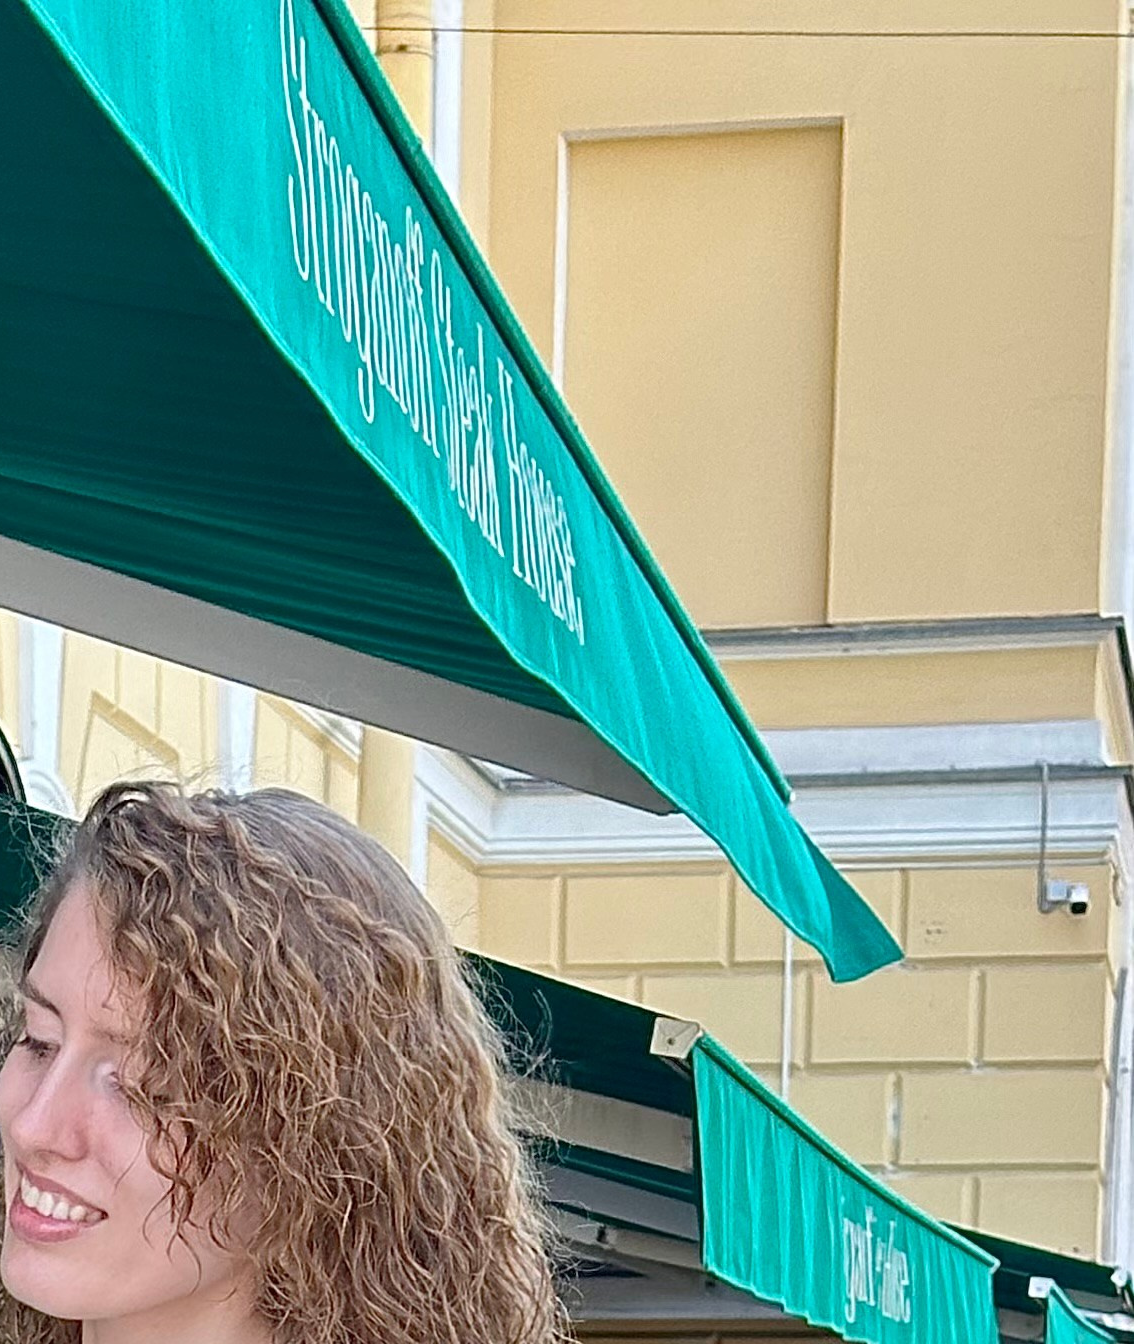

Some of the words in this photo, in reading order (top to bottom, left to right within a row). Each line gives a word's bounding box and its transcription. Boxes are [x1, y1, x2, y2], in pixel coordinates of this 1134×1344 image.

[280, 0, 440, 459] Stroganoff
[430, 249, 504, 558] Steak
[497, 356, 585, 646] House
